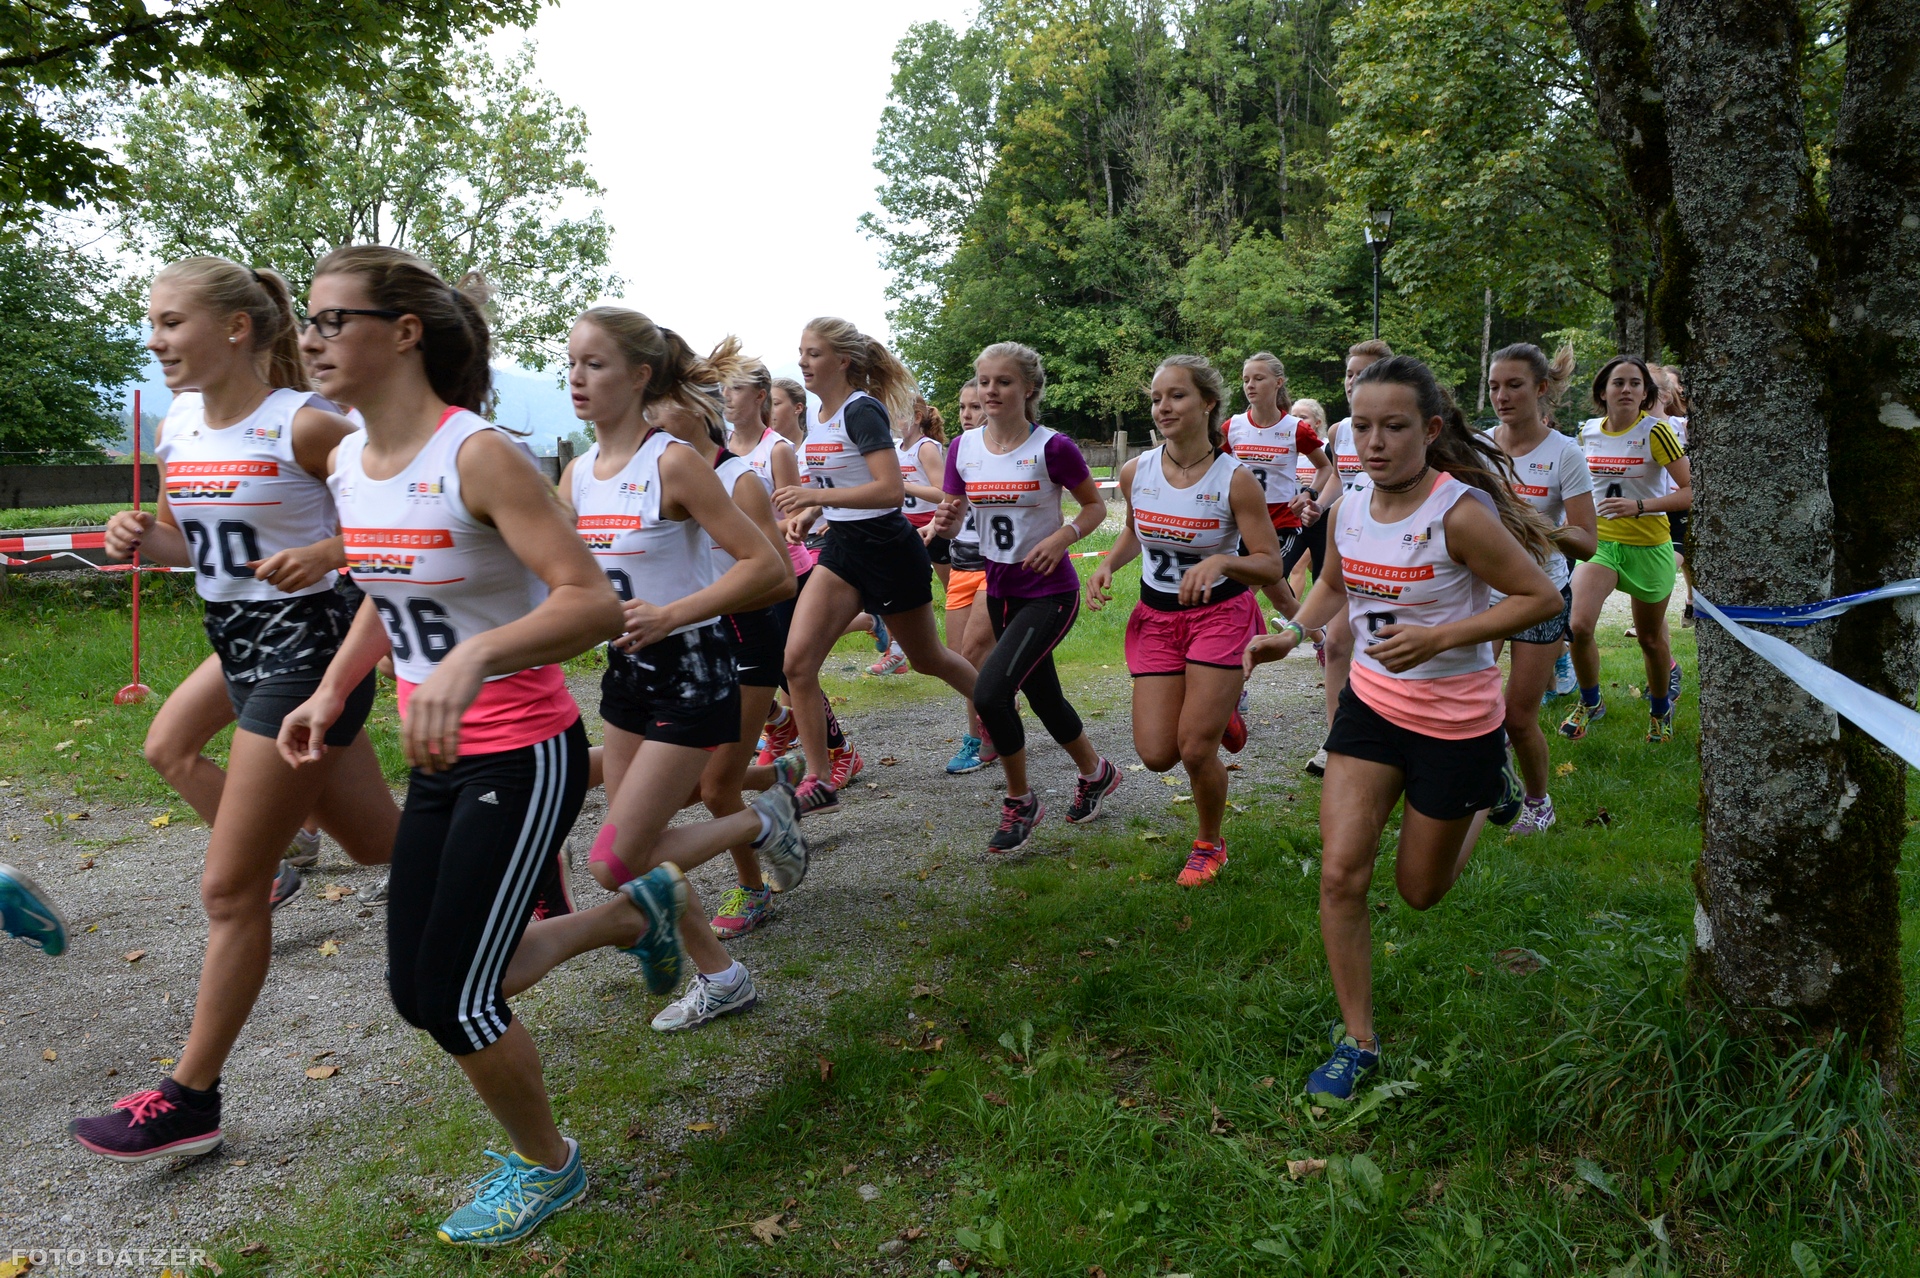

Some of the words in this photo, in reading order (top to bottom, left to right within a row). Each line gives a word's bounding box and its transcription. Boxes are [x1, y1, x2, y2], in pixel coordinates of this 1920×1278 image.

[178, 464, 271, 474] SCHÜLERCUP
[581, 518, 638, 527] SCHÜLERCUP
[1151, 516, 1216, 528] SCHÜLERCUP
[353, 532, 444, 545] SCHÜLERCUP
[990, 514, 1015, 550] 8
[180, 519, 264, 580] 20
[1352, 563, 1428, 579] SCHÜLERCUP
[369, 594, 459, 666] 36
